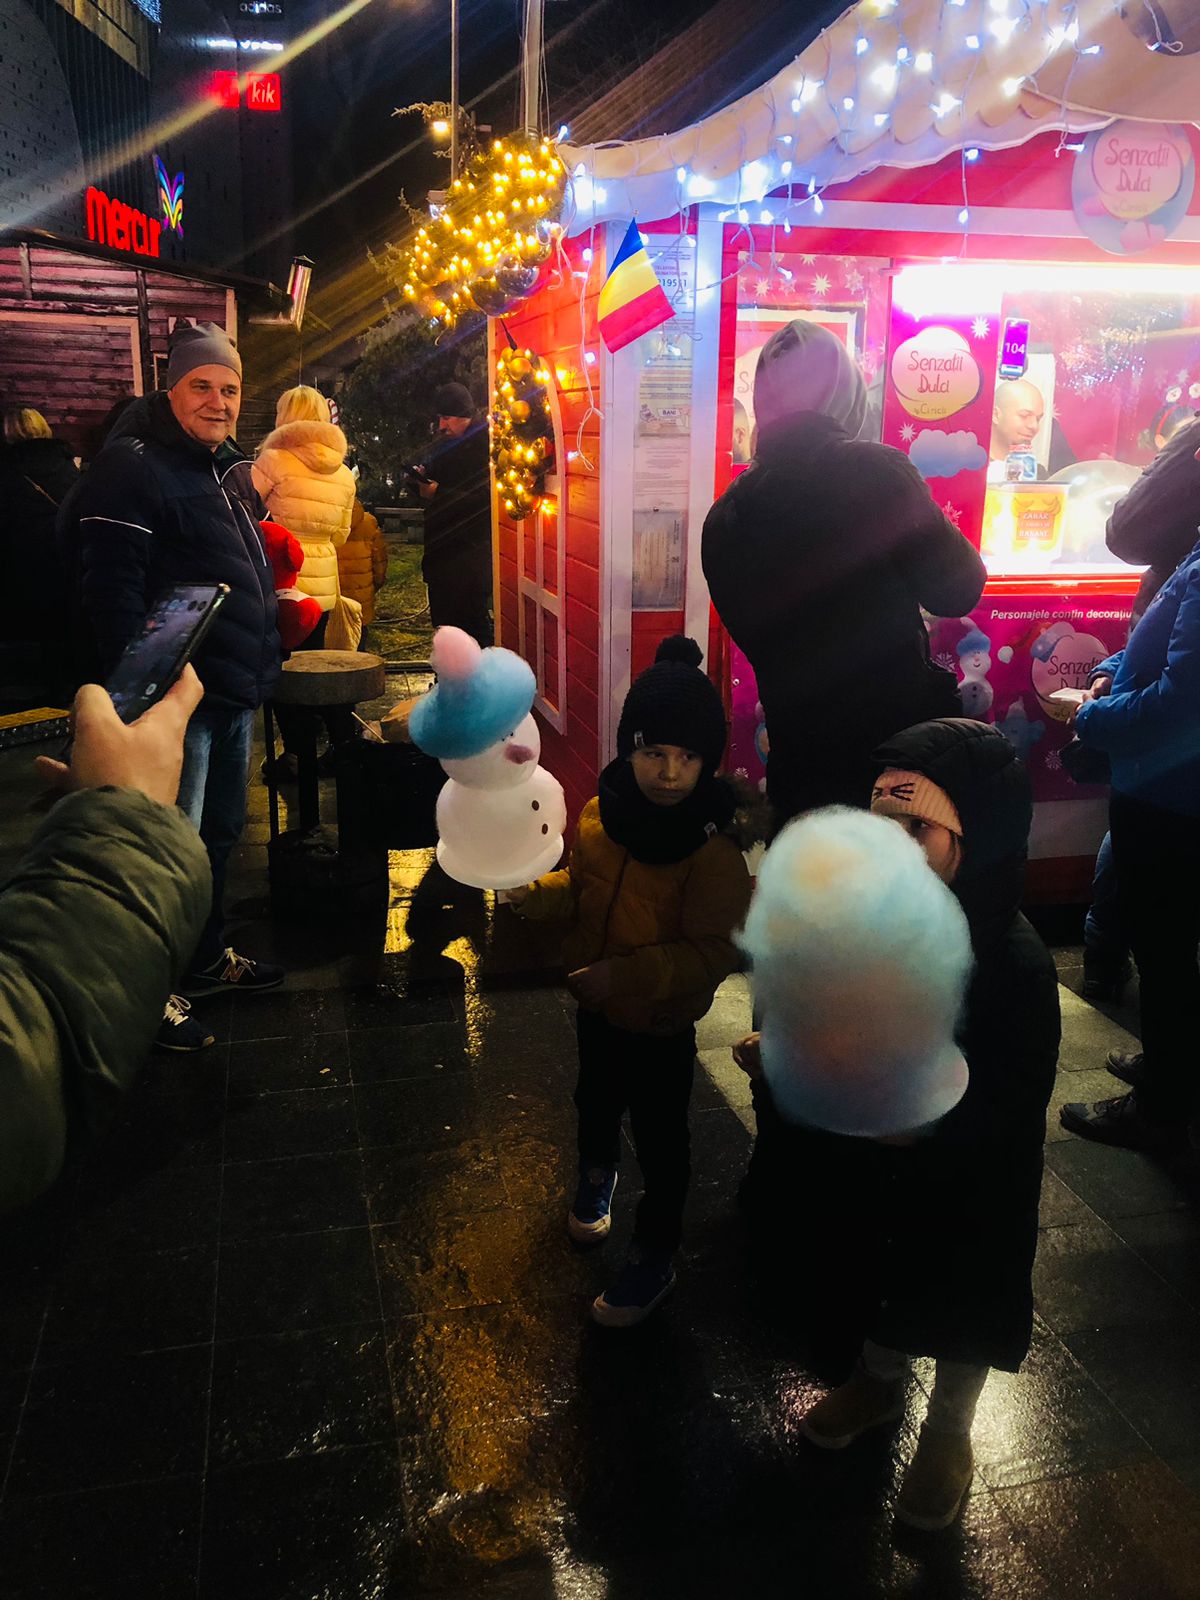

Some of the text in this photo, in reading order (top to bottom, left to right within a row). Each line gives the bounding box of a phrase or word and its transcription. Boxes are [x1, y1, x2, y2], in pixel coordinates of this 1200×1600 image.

[240, 1, 282, 13] adidas
[1005, 342, 1025, 354] 104
[917, 374, 950, 393] Dulci
[991, 609, 1050, 621] Personajele
